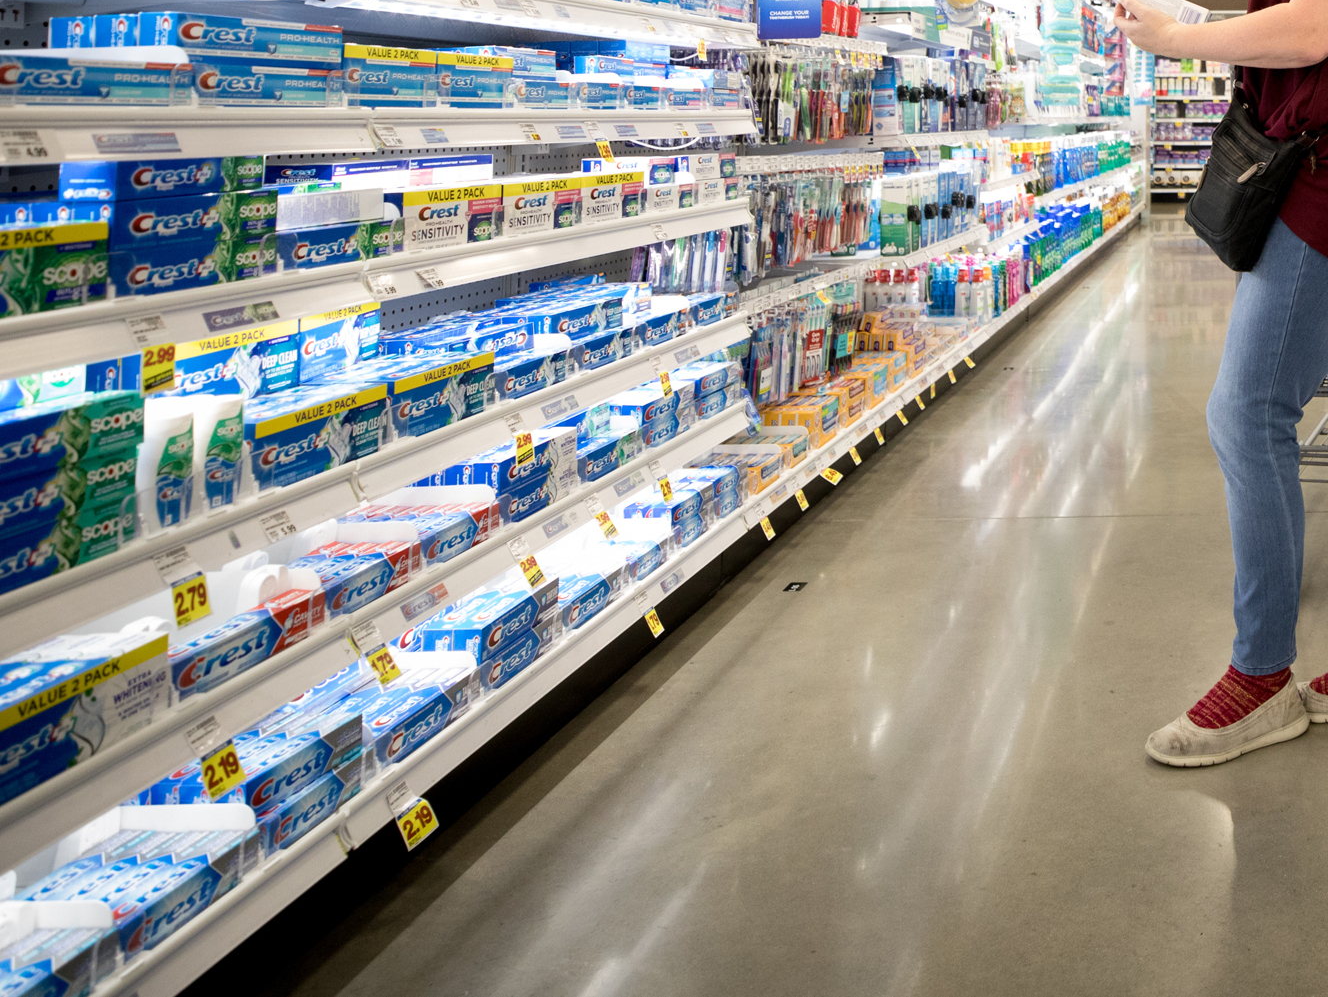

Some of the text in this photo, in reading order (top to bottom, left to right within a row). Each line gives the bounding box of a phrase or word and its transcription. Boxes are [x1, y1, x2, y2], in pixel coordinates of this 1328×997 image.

[180, 22, 257, 45] Crest
[367, 47, 419, 60] VALUE 2 PACK
[0, 64, 86, 88] Crest
[347, 68, 390, 84] Crest
[132, 165, 197, 189] Crest
[237, 163, 262, 178] scope
[239, 201, 276, 221] scope
[418, 205, 461, 221] Crest
[515, 195, 549, 210] Crest
[130, 207, 201, 235] Crest
[13, 229, 54, 245] PACK
[411, 224, 465, 242] SENSITIVITY
[42, 261, 107, 286] scope
[143, 346, 175, 368] 2.99
[262, 349, 298, 369] DEEP CLEAN
[261, 435, 315, 467] Crest
[517, 433, 532, 449] 2.99
[281, 524, 297, 536] 5.99
[427, 523, 474, 560] Crest
[332, 566, 389, 610] Crest
[174, 583, 207, 617] 2.79
[178, 625, 270, 688] Crest
[127, 670, 152, 686] EXTRA
[388, 704, 443, 757] Crest
[204, 752, 240, 790] 2.19
[251, 750, 328, 807] Crest
[402, 806, 433, 841] 2.19
